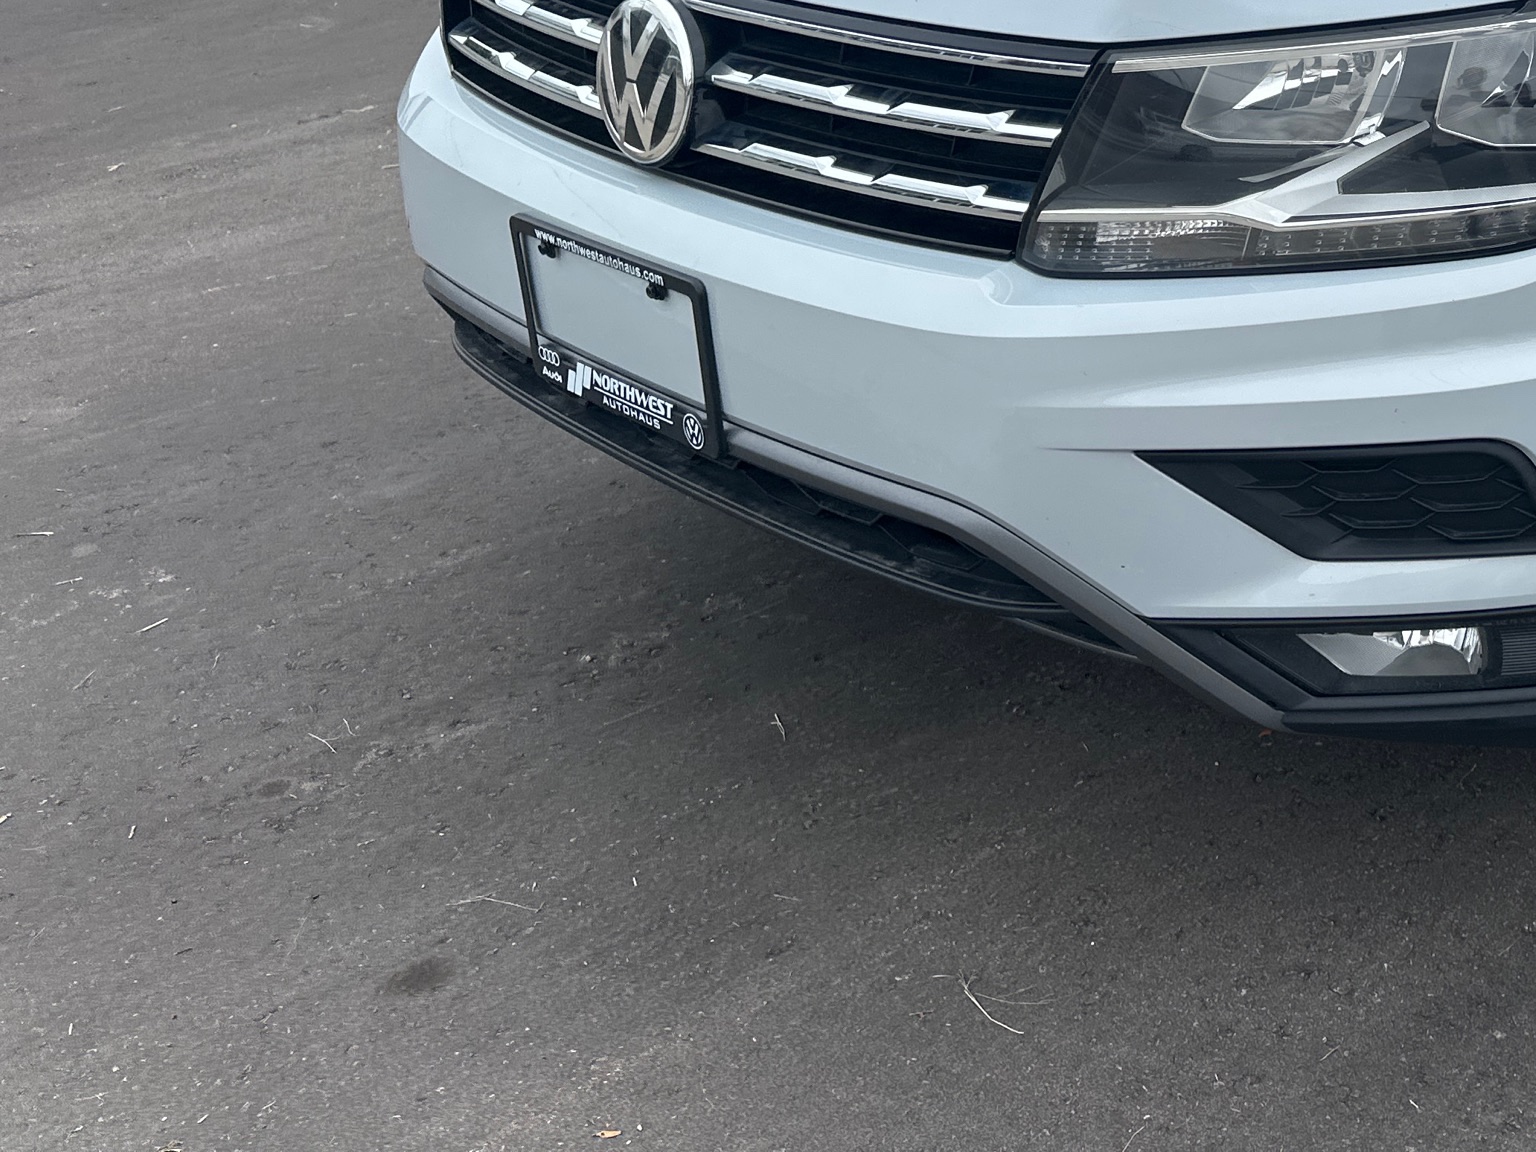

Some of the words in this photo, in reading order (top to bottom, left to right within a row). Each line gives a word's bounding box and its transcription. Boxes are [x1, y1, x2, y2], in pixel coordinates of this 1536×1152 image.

[534, 228, 664, 286] www.northwestautohaus.com
[592, 368, 674, 420] NORTHWEST
[602, 395, 661, 430] AUTOHAUS
